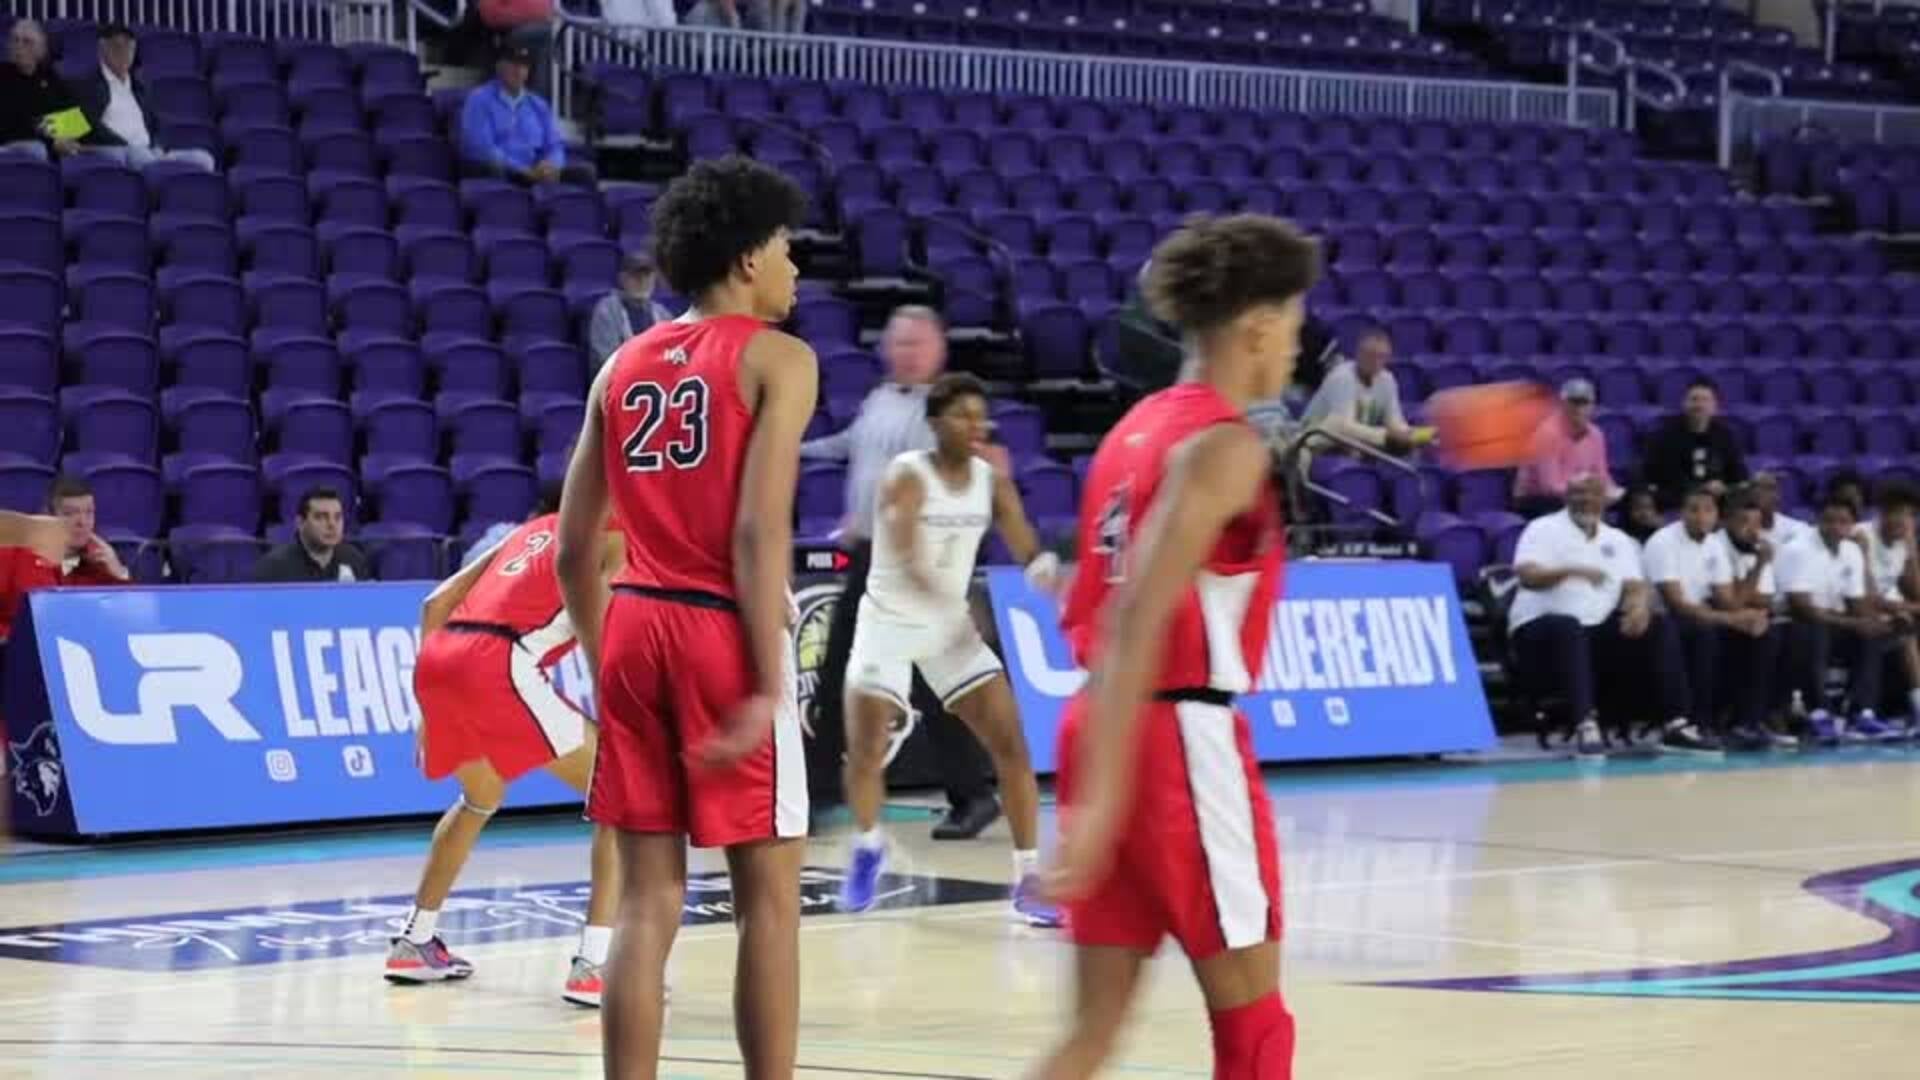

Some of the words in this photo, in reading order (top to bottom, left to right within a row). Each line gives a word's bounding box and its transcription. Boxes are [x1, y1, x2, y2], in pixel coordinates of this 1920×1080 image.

[621, 375, 709, 473] 23
[498, 530, 553, 577] 2
[1257, 596, 1456, 690] UEREADY
